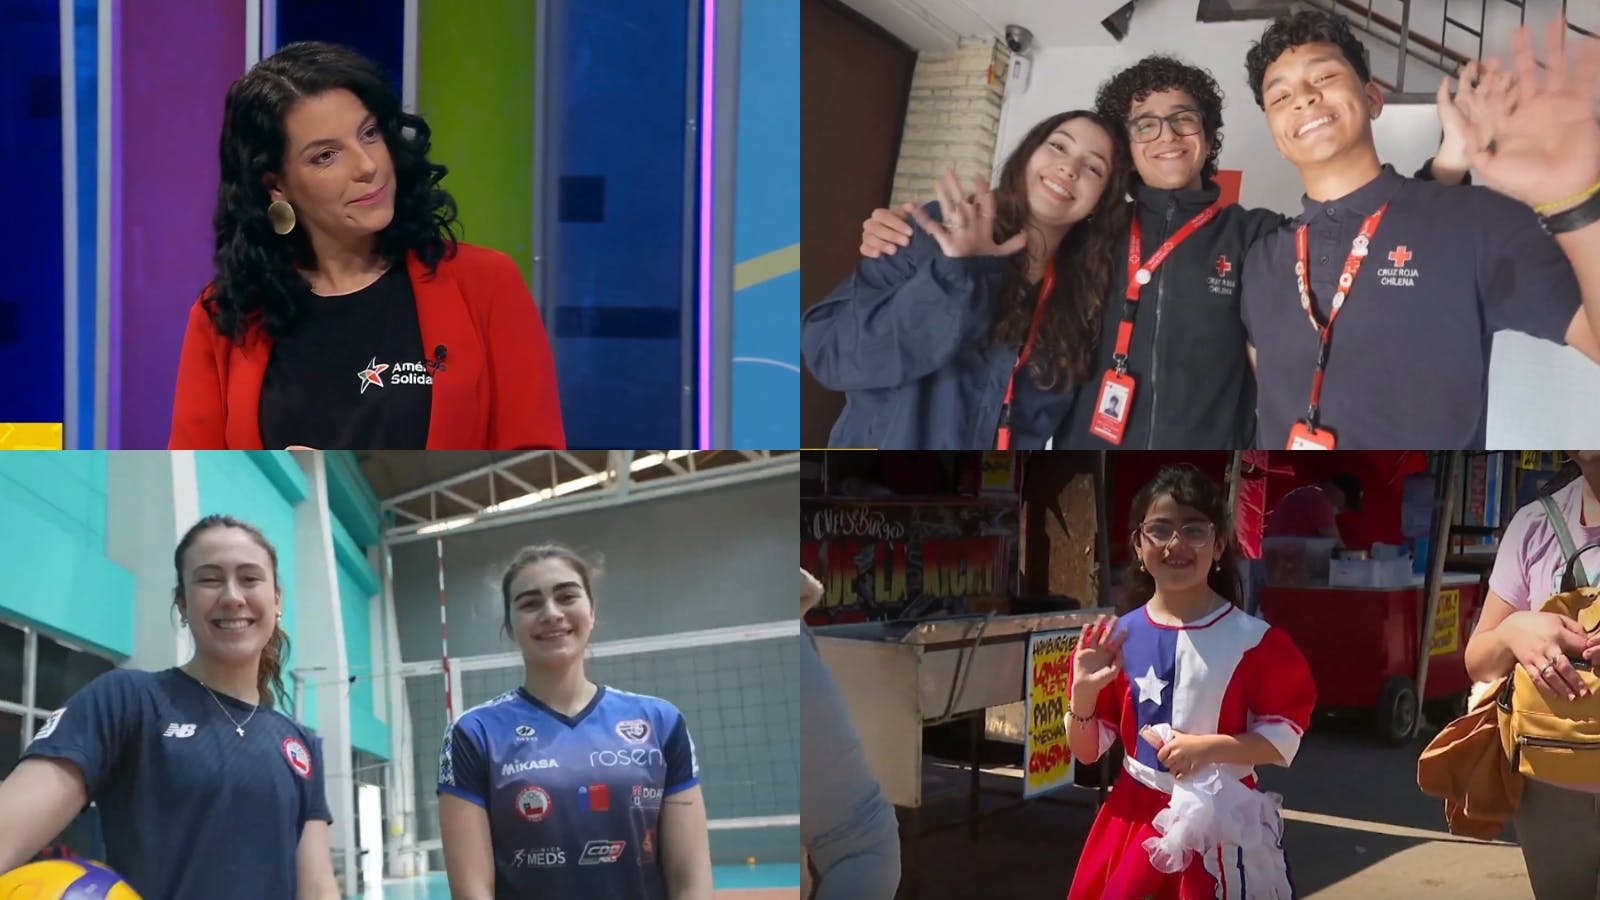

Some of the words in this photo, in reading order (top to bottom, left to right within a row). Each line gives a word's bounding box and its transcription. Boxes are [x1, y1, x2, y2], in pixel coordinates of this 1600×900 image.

[1377, 268, 1397, 276] CRUZ
[1398, 268, 1419, 278] ROJA
[1380, 277, 1415, 286] CHILENA
[1033, 699, 1063, 730] PAPA
[163, 723, 197, 738] NB
[590, 748, 662, 768] rosen
[527, 851, 567, 865] MEDS
